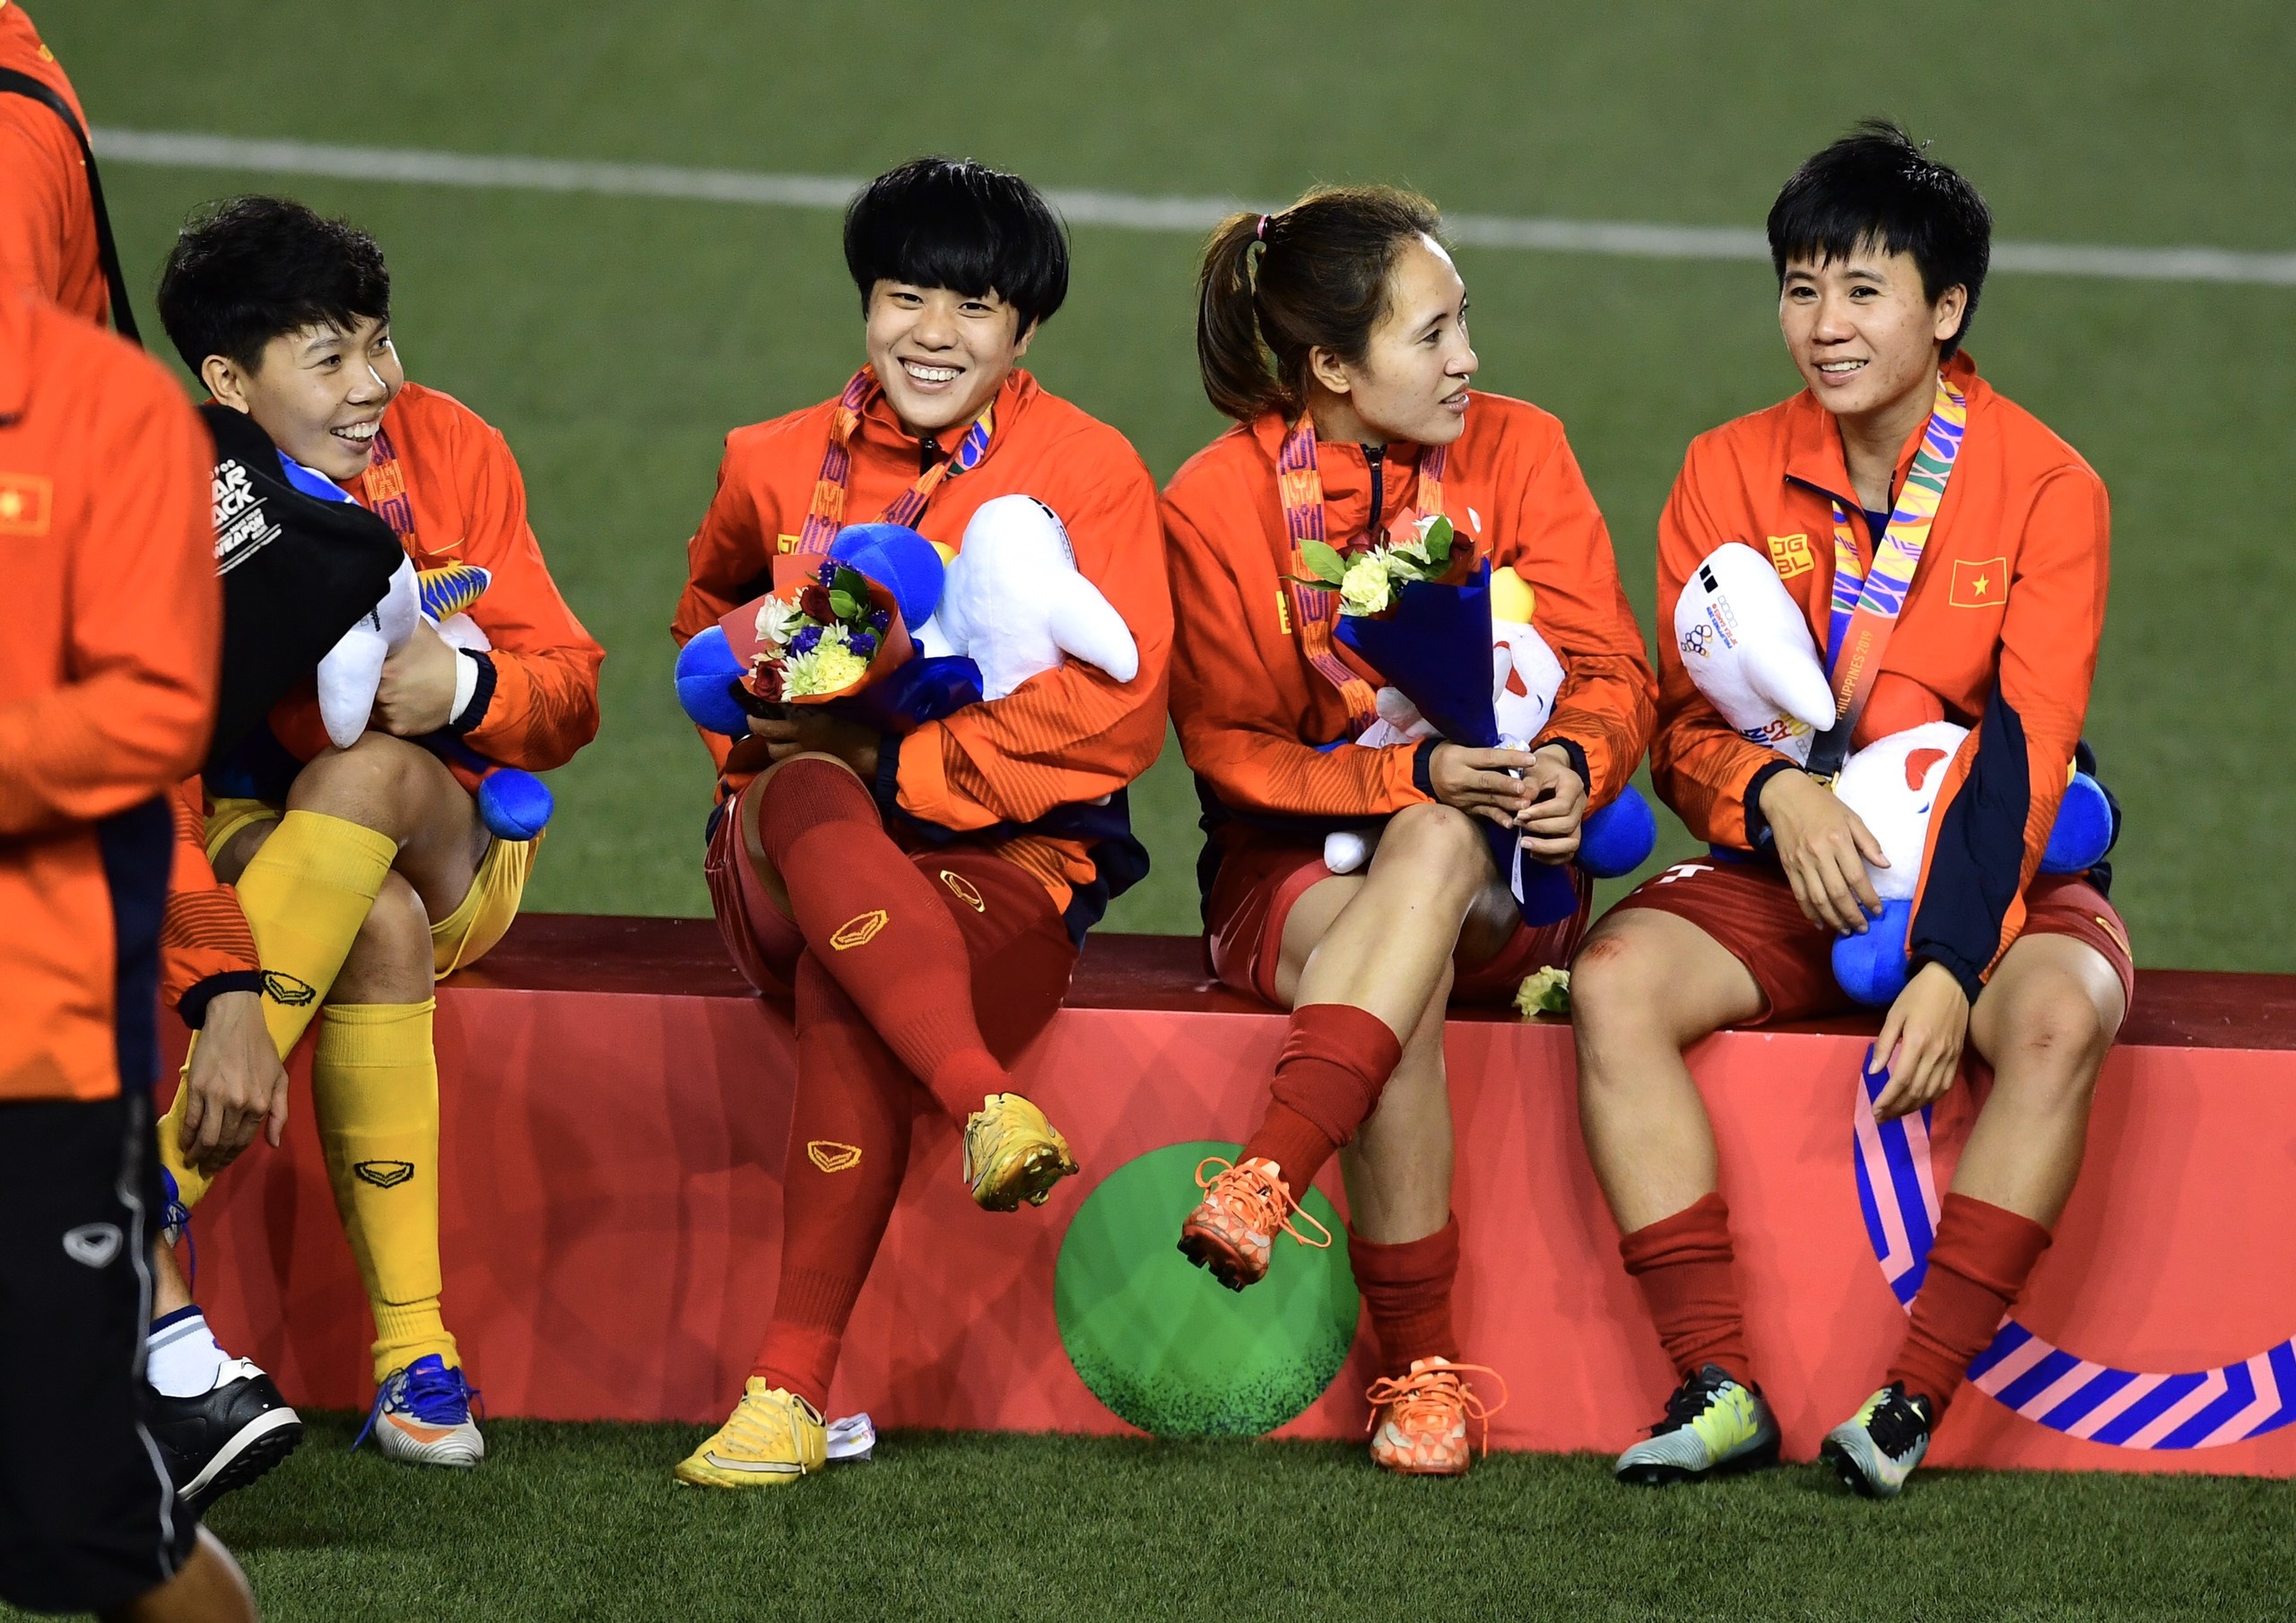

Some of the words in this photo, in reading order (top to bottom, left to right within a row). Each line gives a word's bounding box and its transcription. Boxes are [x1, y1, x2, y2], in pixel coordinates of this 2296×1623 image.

[213, 513, 265, 560] WEAPON
[1836, 654, 1866, 720] PHILIPPINES
[1856, 630, 1874, 656] 2019
[1763, 719, 1792, 742] AS
